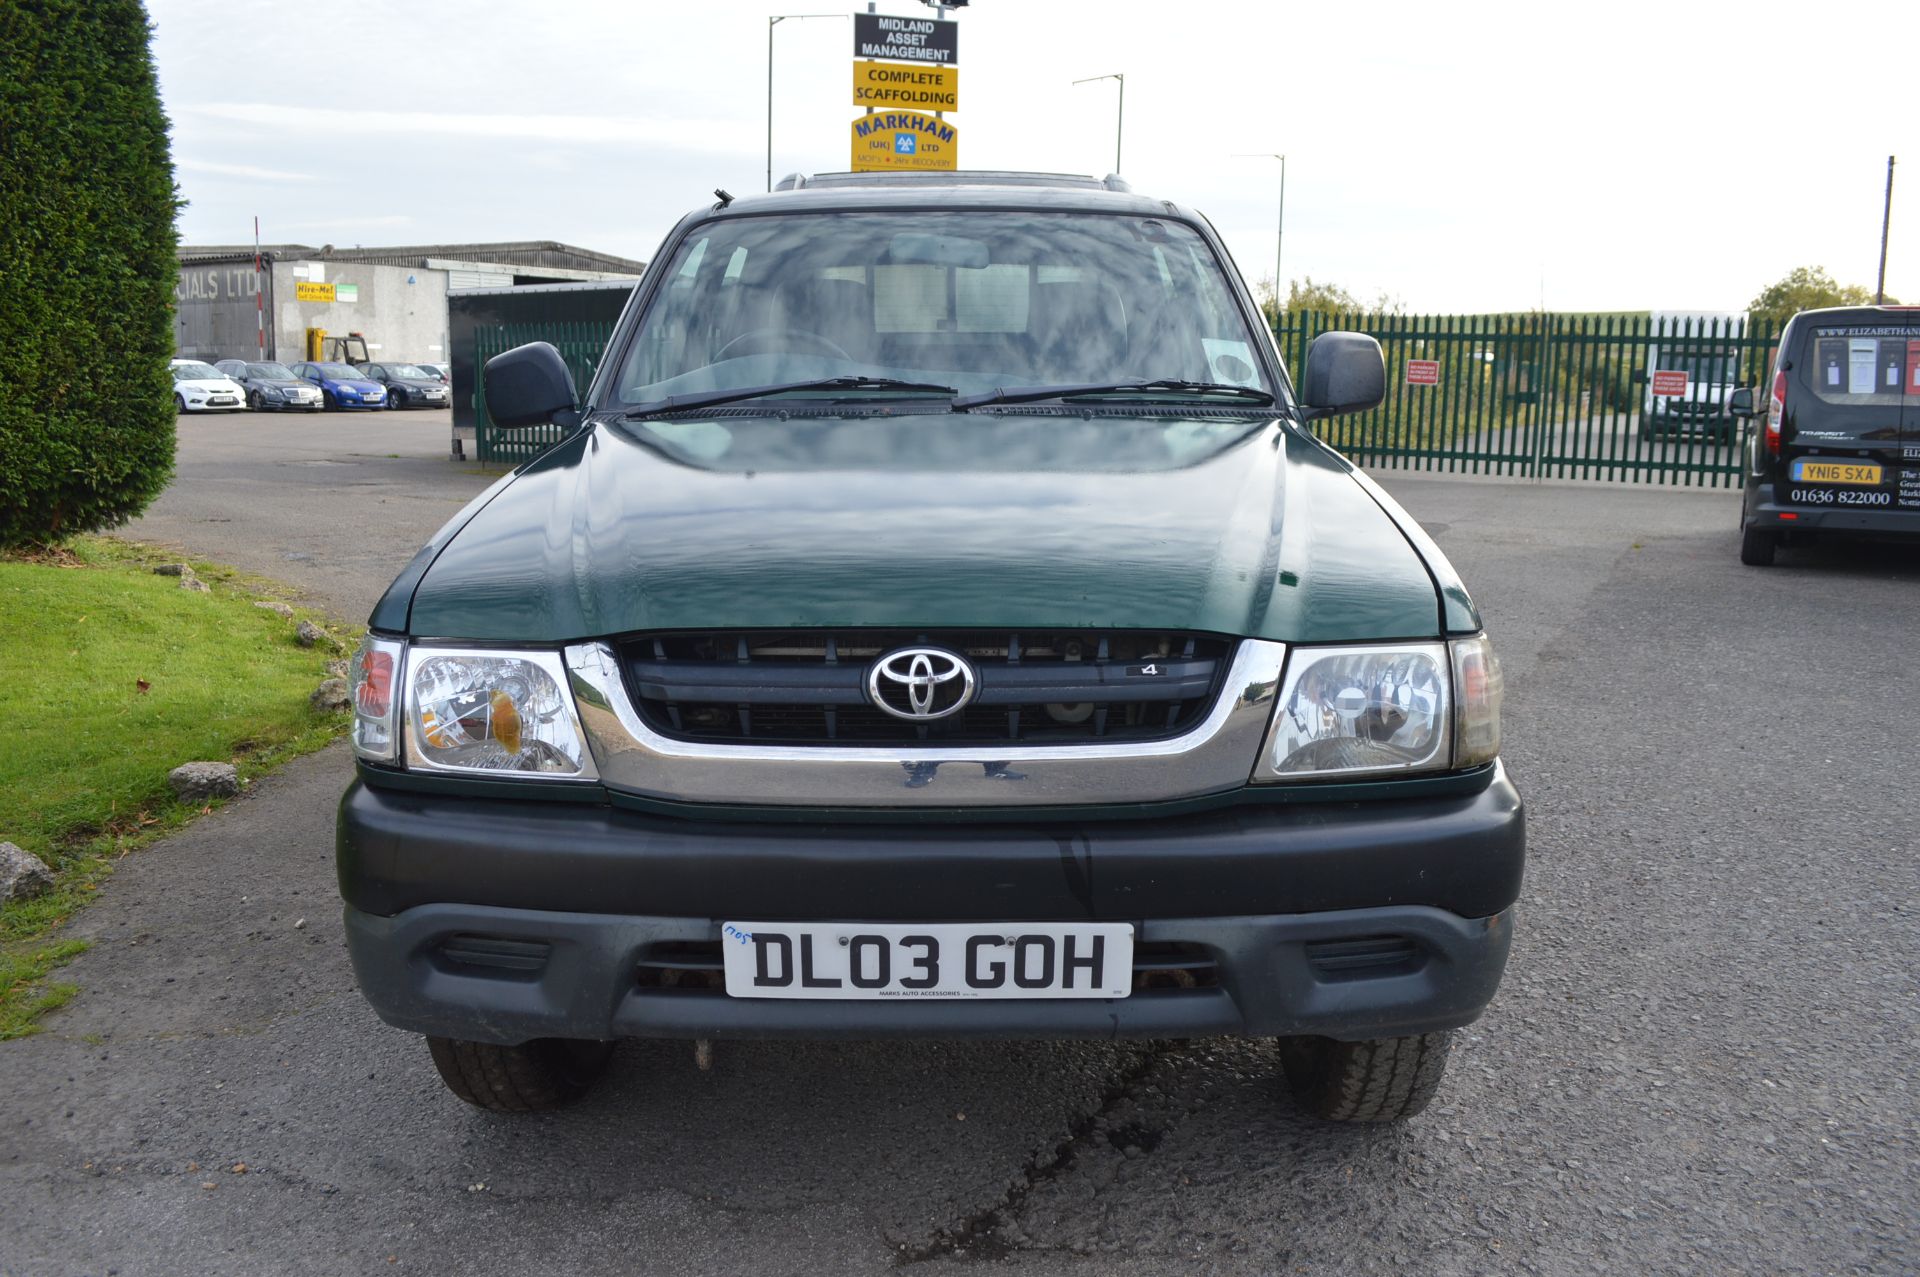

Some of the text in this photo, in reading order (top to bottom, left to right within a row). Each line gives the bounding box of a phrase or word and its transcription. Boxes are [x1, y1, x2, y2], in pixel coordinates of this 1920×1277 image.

[878, 18, 935, 32] MIDLAND
[886, 32, 928, 46] ASSET
[862, 43, 950, 60] MANAGEMENT
[868, 69, 944, 86] COMPLETE
[856, 87, 955, 105] SCAFFOLDING
[855, 114, 954, 143] MARKHAM
[869, 140, 940, 153] (UK) LTD
[912, 156, 951, 167] RECOVERY
[226, 268, 258, 297] LTD
[1816, 327, 1920, 337] WWW.ELIZABETHAN
[1807, 466, 1874, 481] YN16 SXA
[1901, 471, 1915, 480] The
[1792, 489, 1891, 506] 01636 822000
[1141, 663, 1158, 676] 4
[752, 932, 1106, 990] DL03 GOH
